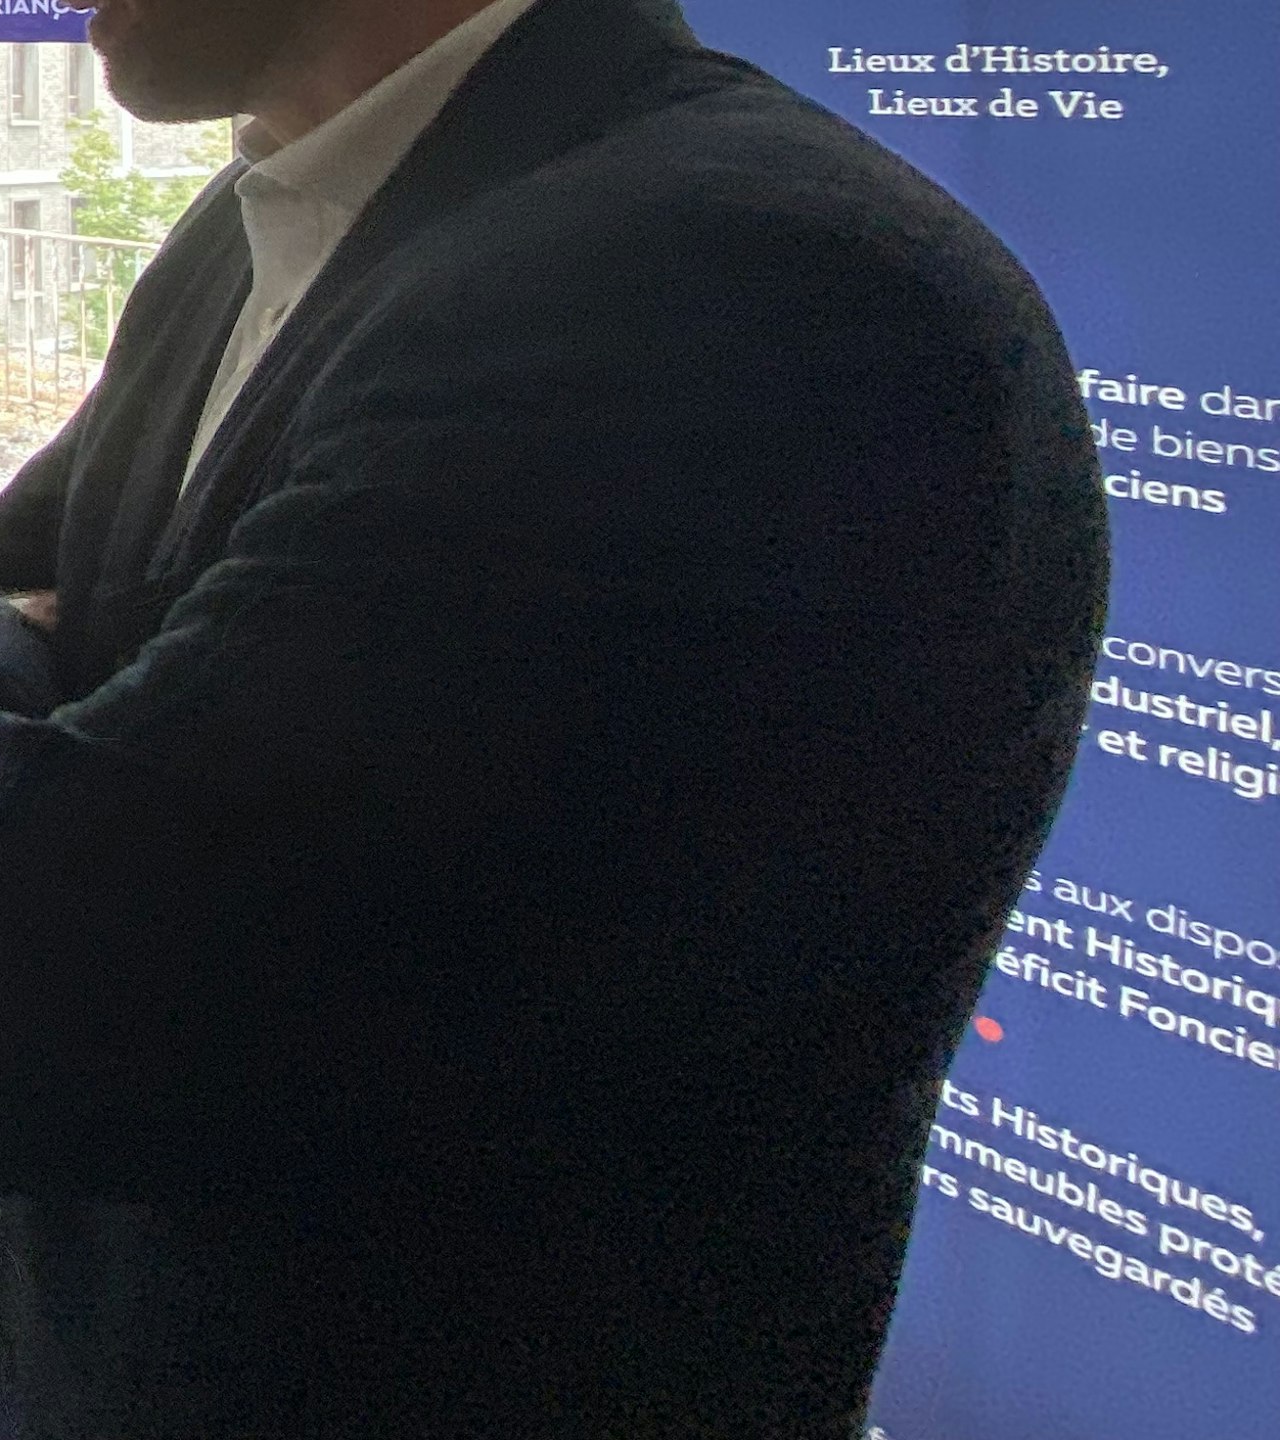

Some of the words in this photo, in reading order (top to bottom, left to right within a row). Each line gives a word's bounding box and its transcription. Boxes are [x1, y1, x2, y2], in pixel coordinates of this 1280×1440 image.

[828, 47, 936, 73] Lieux
[945, 43, 1169, 78] d’Histoire,
[868, 88, 978, 117] Lieux
[989, 88, 1038, 118] de
[1049, 90, 1124, 119] Vie
[1077, 368, 1186, 410] faire
[1152, 425, 1280, 472] biens
[1104, 469, 1227, 513] ciens
[1102, 636, 1280, 696] convers
[1092, 675, 1280, 751] dustriel,
[1097, 729, 1148, 761] et
[1158, 747, 1279, 800] religi
[1053, 878, 1134, 922] aux
[1145, 904, 1280, 968] dispo
[996, 946, 1108, 1009] éficit
[1120, 985, 1280, 1071] Foncie
[1086, 926, 1280, 1028] Historiq
[992, 1097, 1265, 1244] Historiques,
[922, 1165, 959, 1198] rs
[969, 1187, 1256, 1334] sauvegardés
